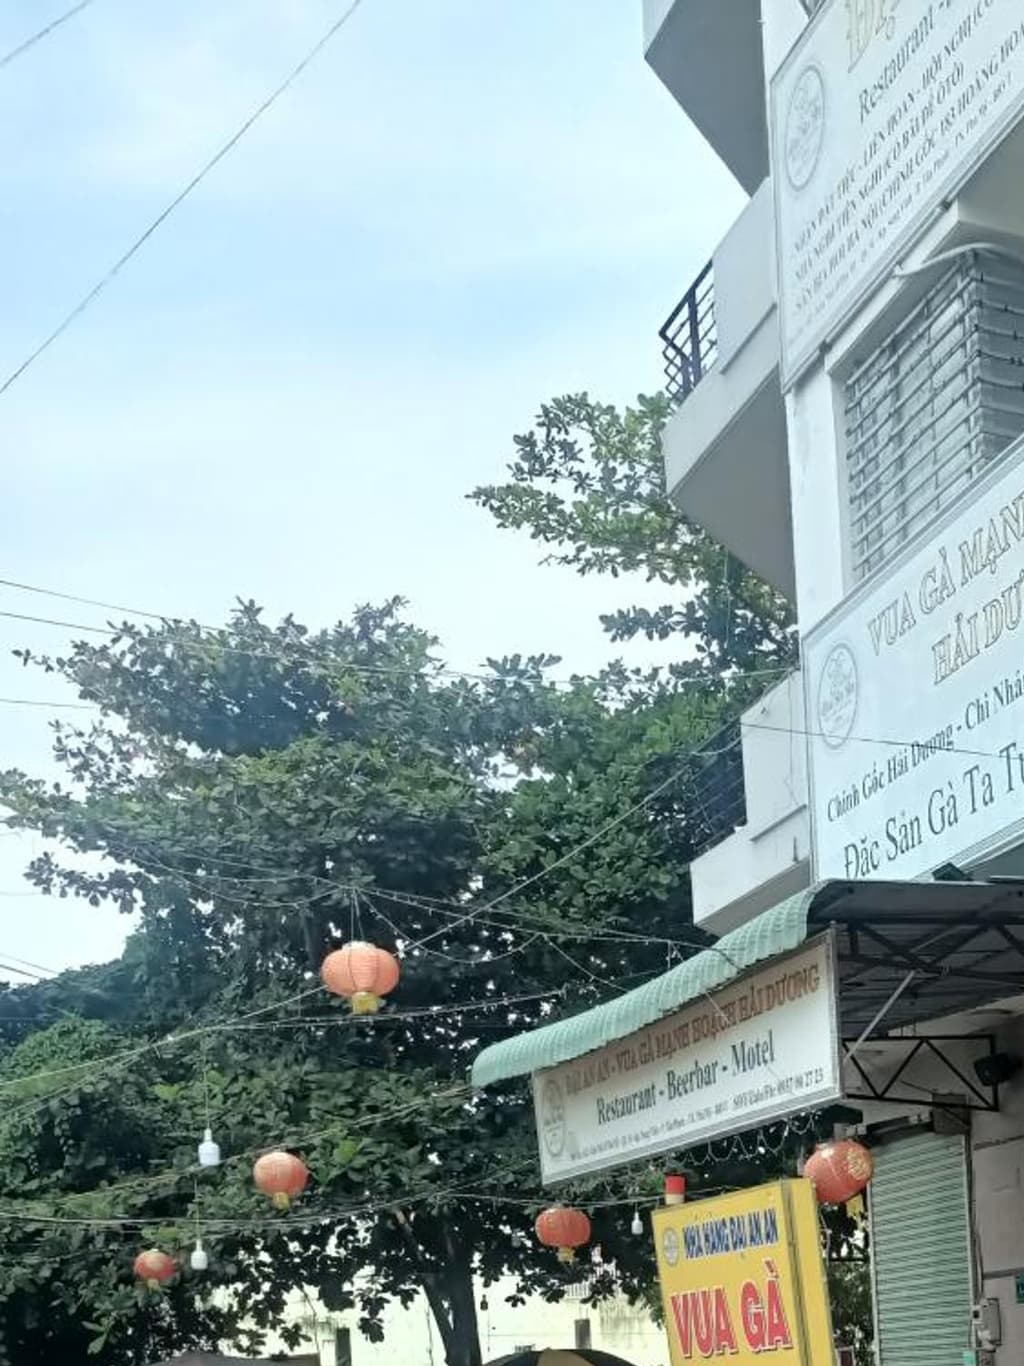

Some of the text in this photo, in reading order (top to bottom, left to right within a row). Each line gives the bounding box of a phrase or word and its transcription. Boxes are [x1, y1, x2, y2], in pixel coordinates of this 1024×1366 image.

[858, 4, 934, 125] Restaurant
[866, 590, 917, 657] VUA
[918, 546, 957, 615] GÀ
[931, 612, 981, 686] HẢI
[885, 810, 922, 861] Sản
[927, 780, 959, 835] Gà
[962, 764, 995, 817] Ta
[597, 1083, 657, 1125] Restaurant
[666, 1058, 719, 1101] Beerbar
[730, 1029, 775, 1077] Motel
[671, 1259, 794, 1359] VUA GÀ
